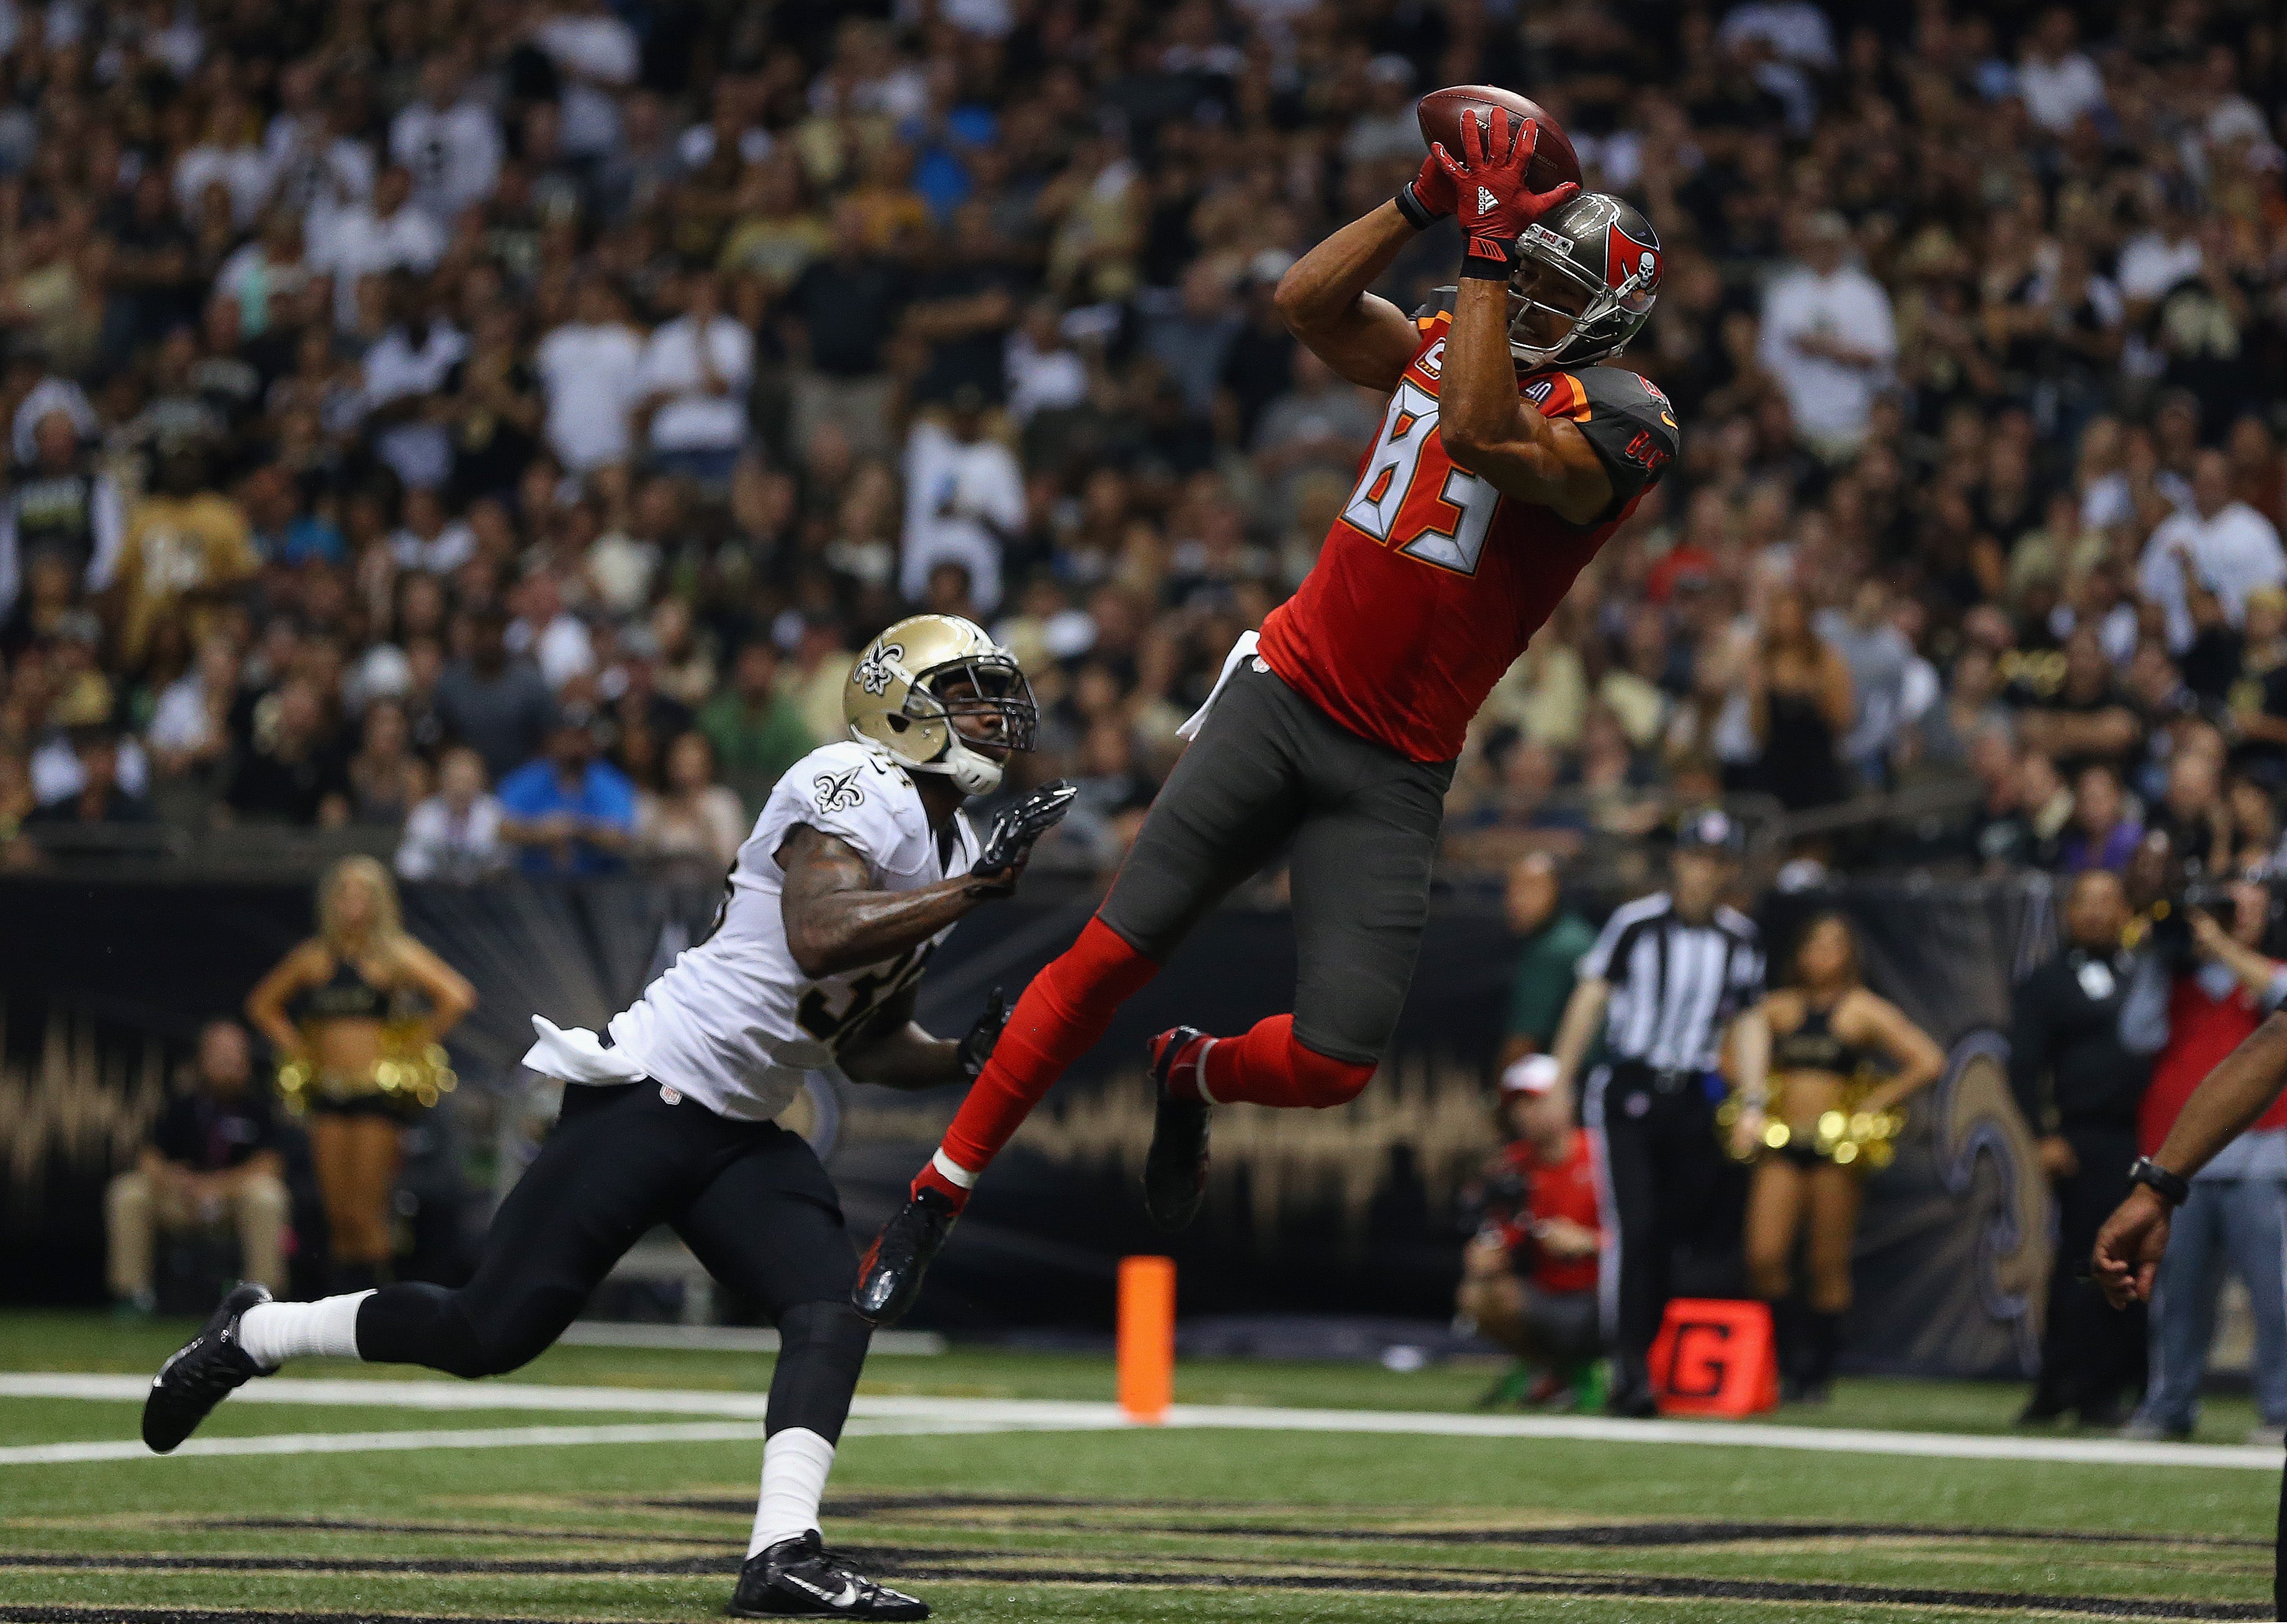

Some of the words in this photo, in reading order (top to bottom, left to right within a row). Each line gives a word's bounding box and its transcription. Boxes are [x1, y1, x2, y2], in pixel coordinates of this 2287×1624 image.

[1477, 186, 1486, 215] adidas
[1339, 374, 1501, 579] 83
[1667, 1320, 1731, 1397] G
